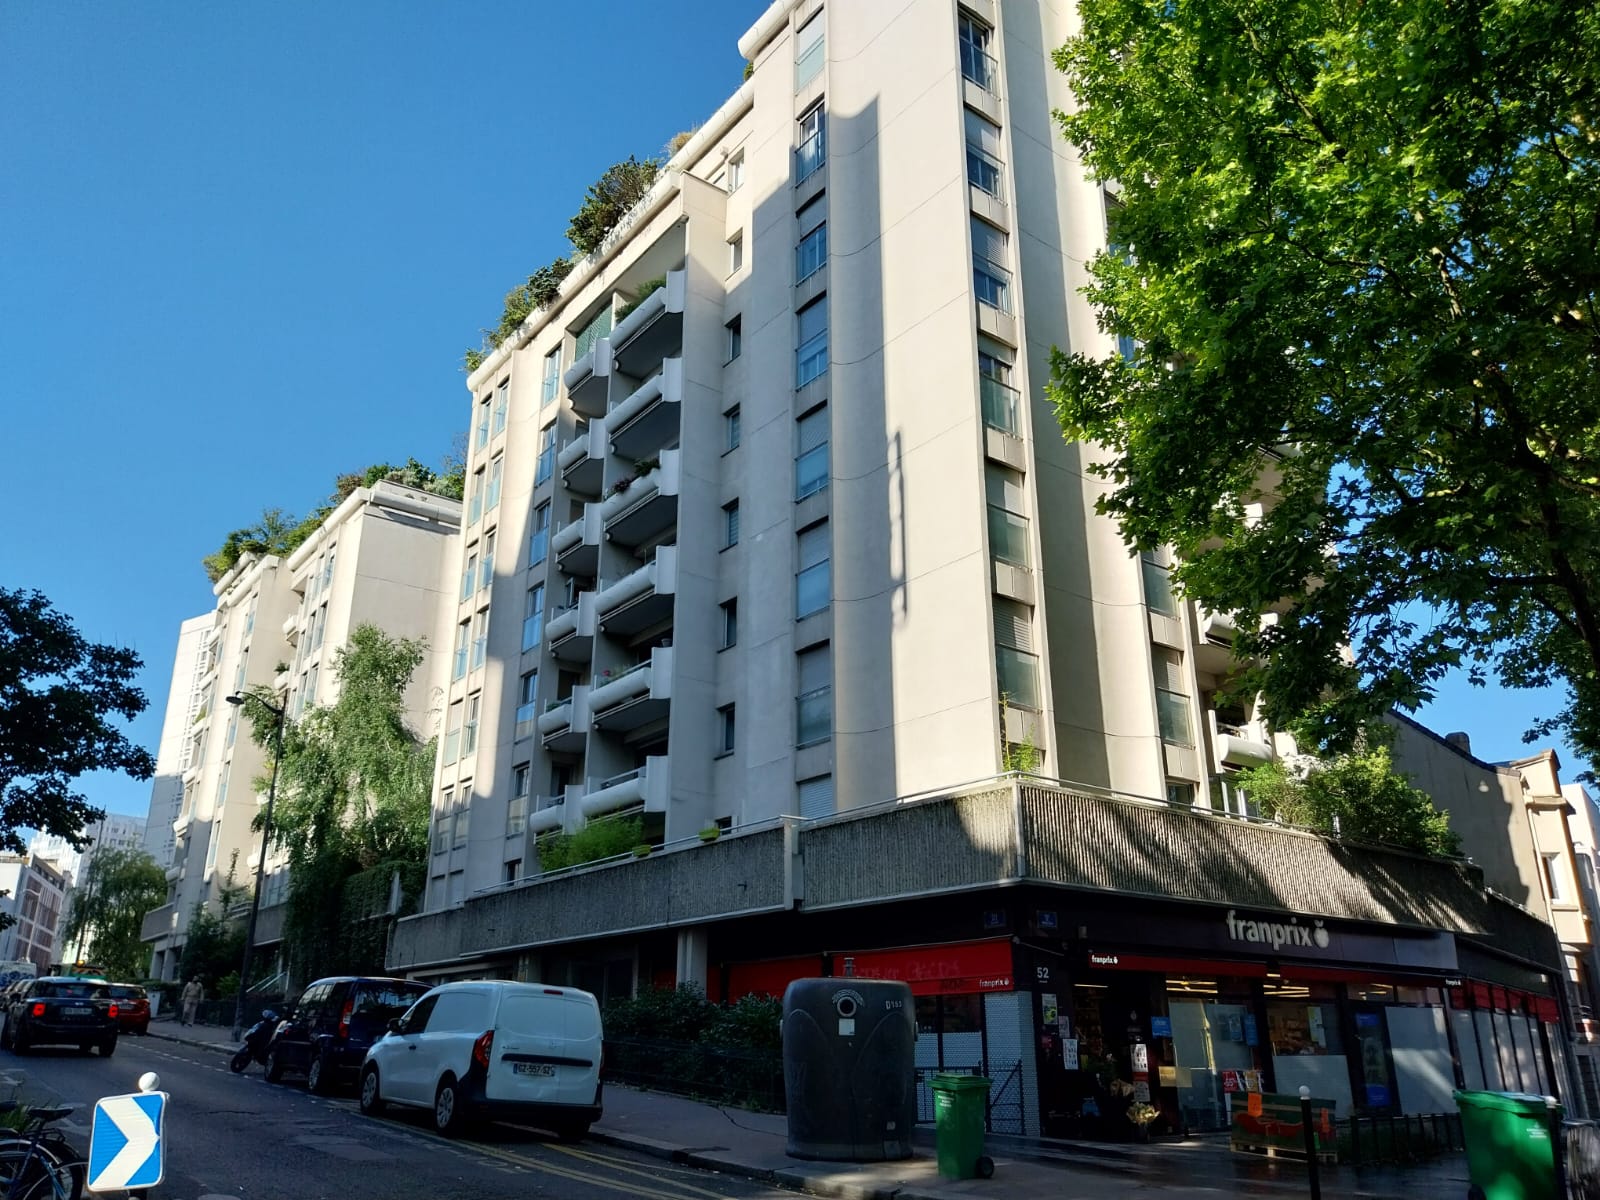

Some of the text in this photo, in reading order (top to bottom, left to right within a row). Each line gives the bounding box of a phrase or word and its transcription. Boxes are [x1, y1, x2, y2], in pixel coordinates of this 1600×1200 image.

[1226, 909, 1312, 950] franprix
[1037, 967, 1050, 979] 52
[979, 979, 1004, 988] franprix
